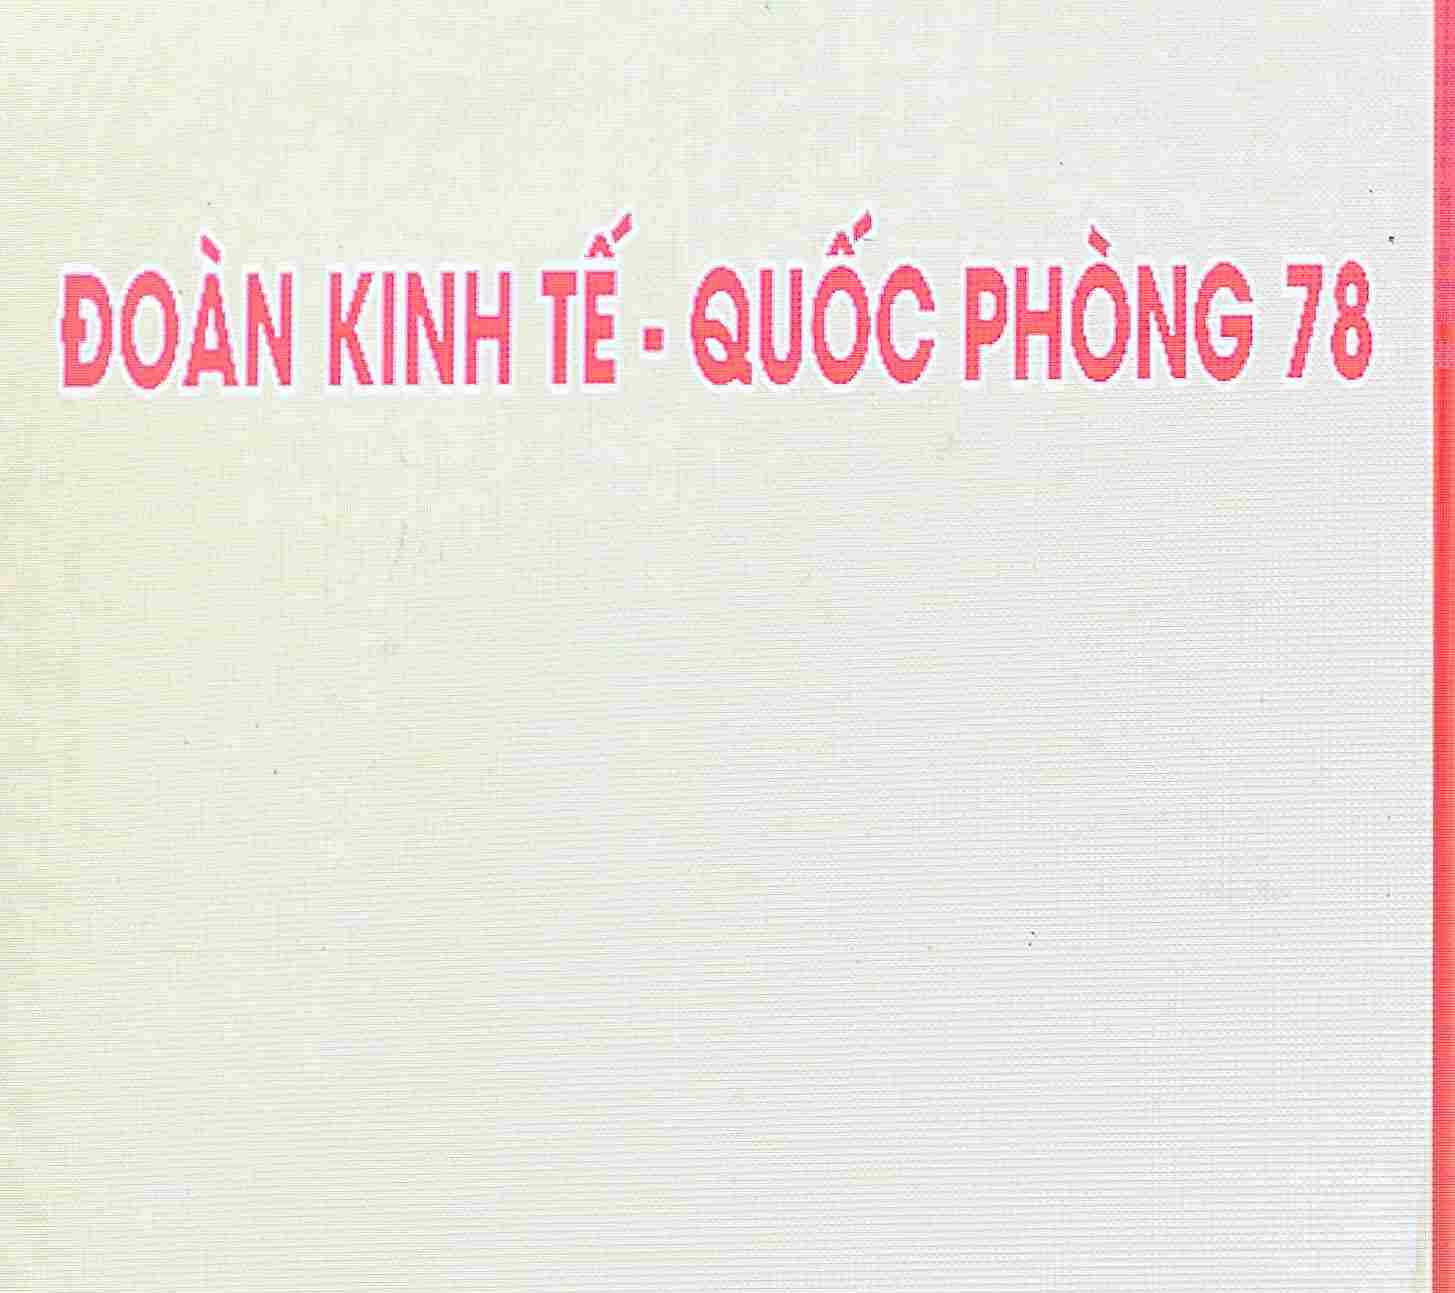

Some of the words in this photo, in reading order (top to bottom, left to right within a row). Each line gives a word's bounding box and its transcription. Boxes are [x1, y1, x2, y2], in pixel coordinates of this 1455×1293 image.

[60, 237, 294, 391] ĐOÀN
[327, 270, 512, 386] KINH
[541, 215, 632, 386] TẾ
[689, 213, 937, 386] QUỐC
[963, 228, 1255, 384] PHÒNG
[1285, 259, 1374, 381] 78
